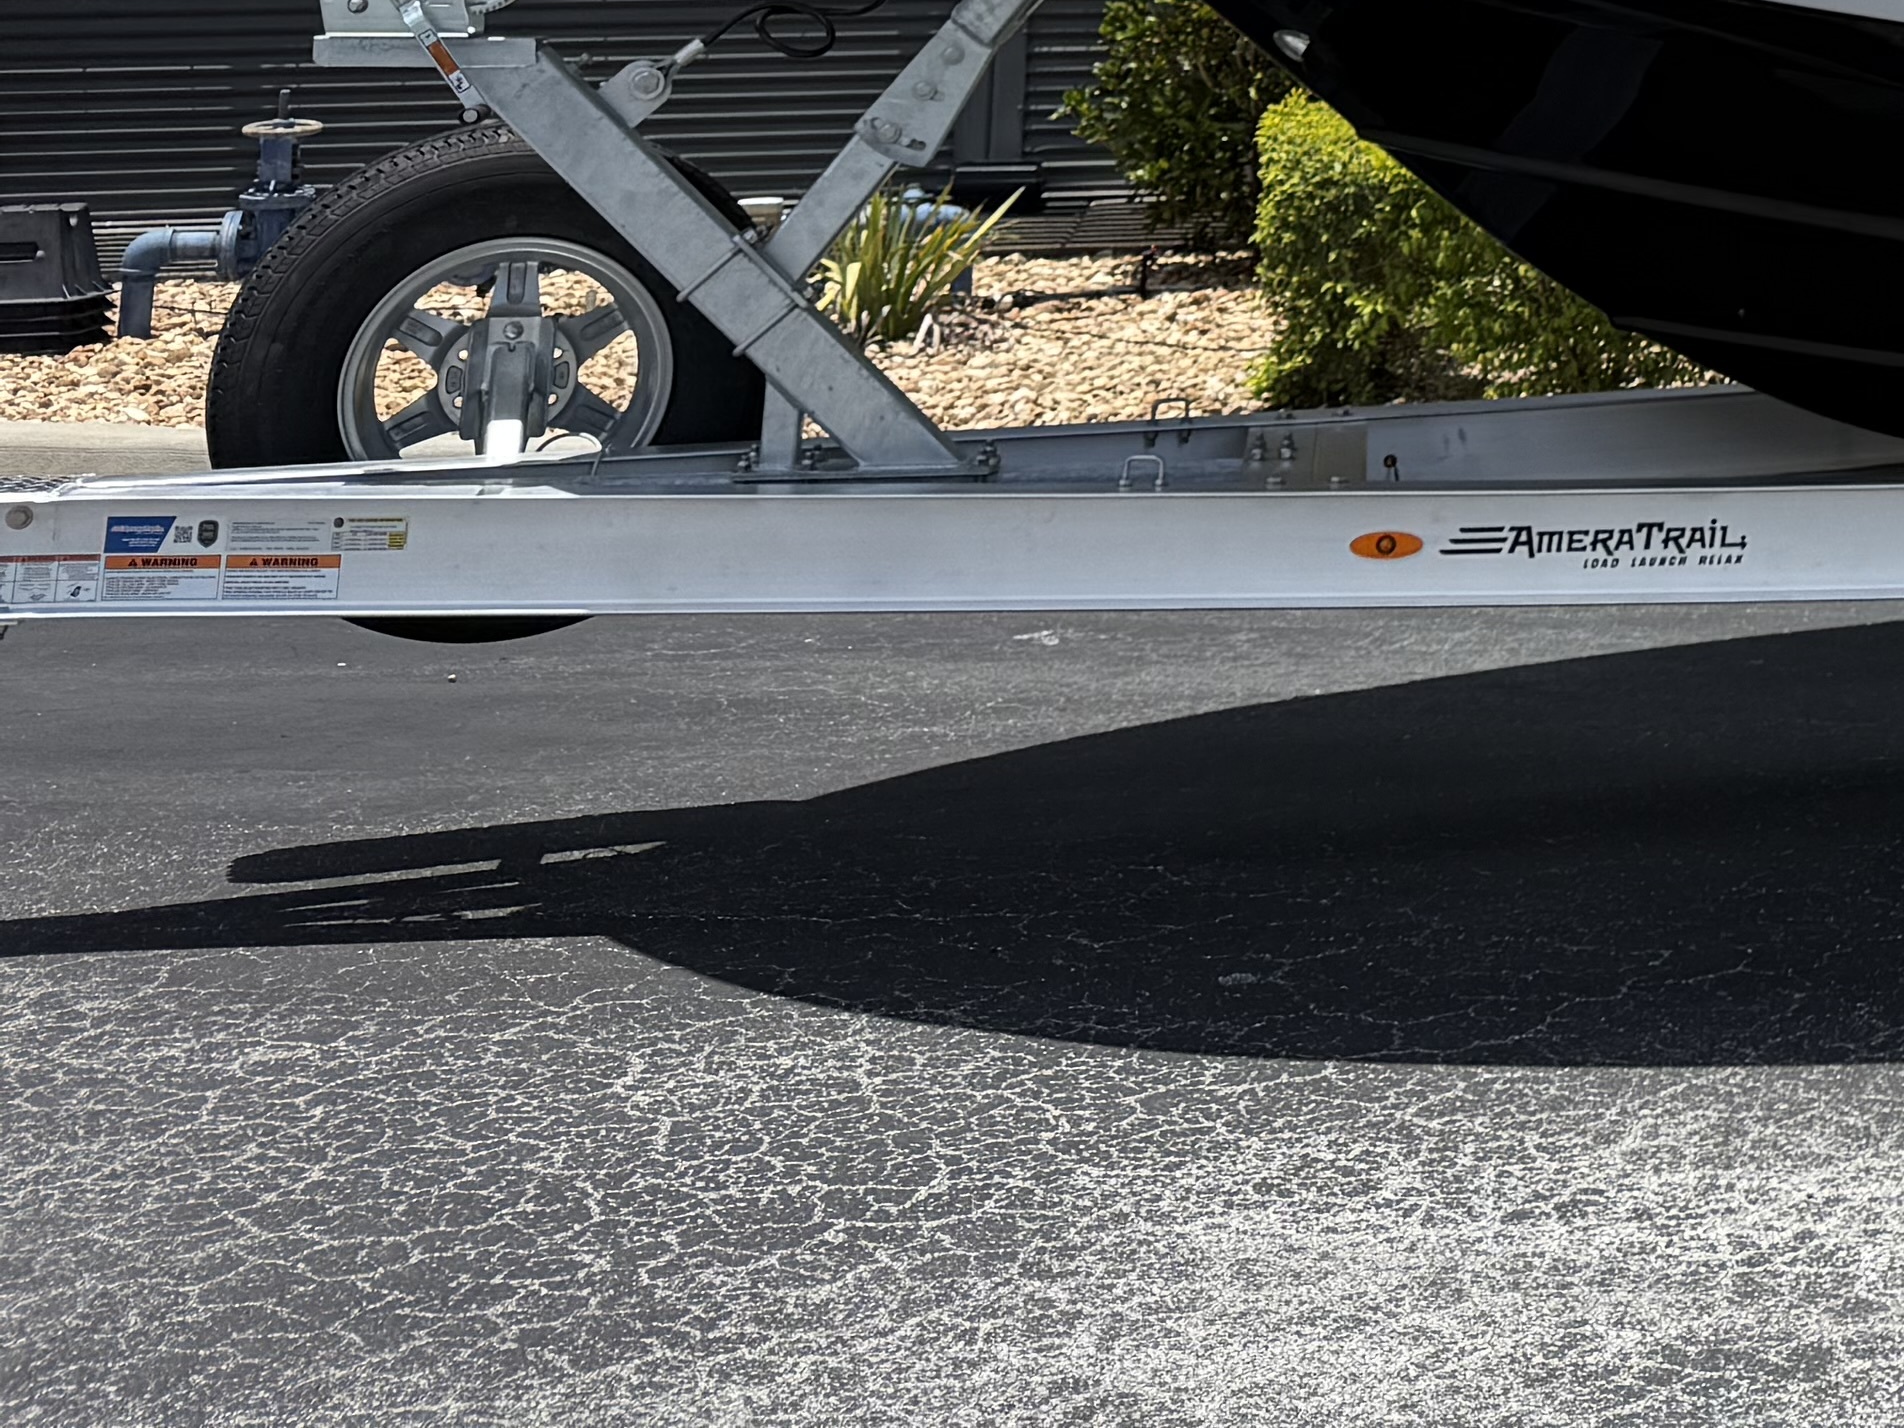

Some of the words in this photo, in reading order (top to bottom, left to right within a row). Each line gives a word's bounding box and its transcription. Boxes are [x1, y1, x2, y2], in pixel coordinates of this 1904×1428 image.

[140, 557, 198, 567] WARNING
[261, 557, 319, 567] WARNING
[1583, 557, 1620, 570] LOAD
[1630, 554, 1688, 569] LAUNCH
[1698, 553, 1745, 566] RELAX
